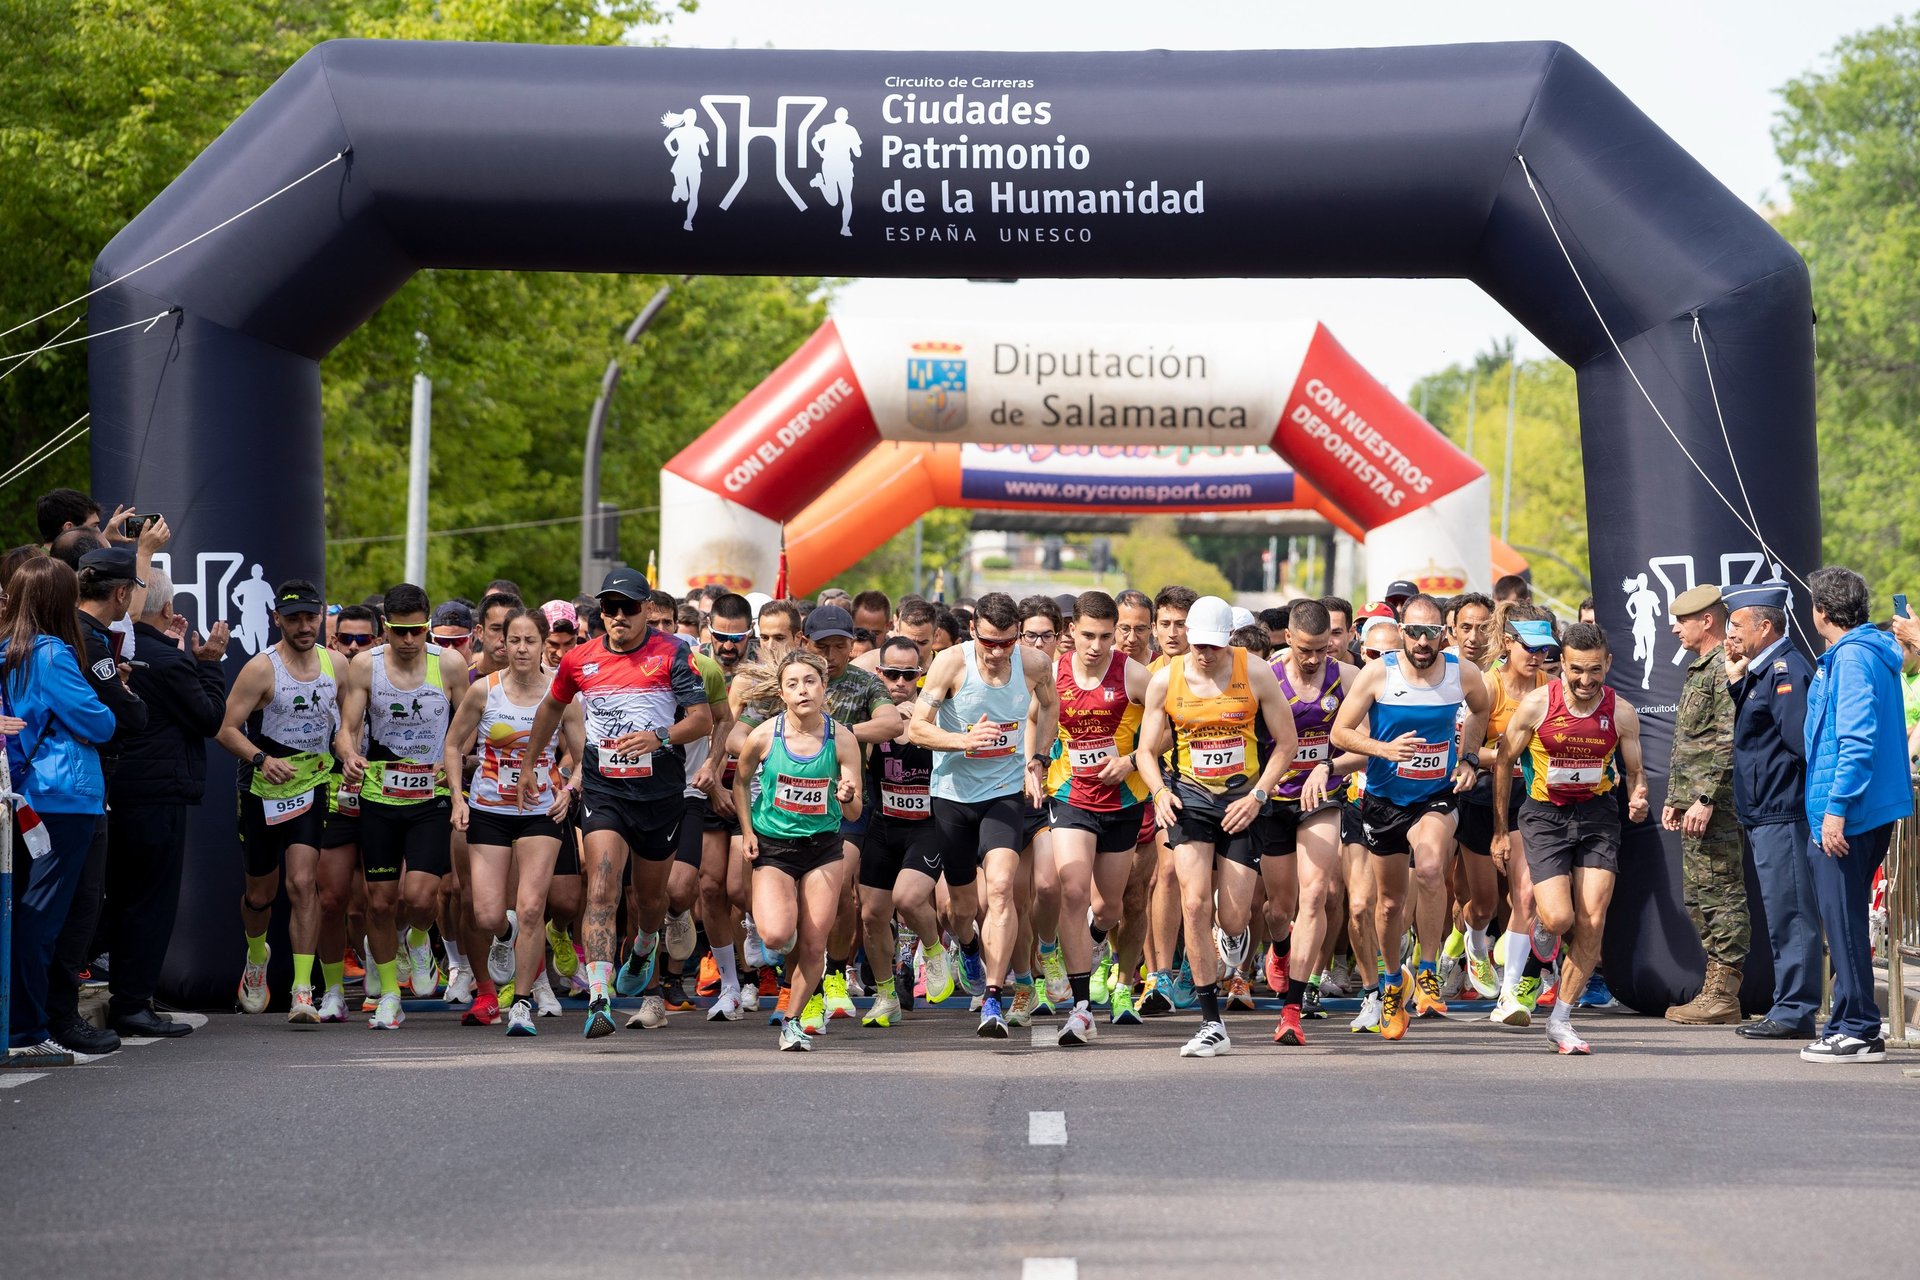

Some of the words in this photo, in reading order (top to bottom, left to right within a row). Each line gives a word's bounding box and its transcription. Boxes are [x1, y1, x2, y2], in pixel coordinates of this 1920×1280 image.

[885, 76, 944, 88] Circuito
[948, 76, 968, 88] de
[971, 76, 1035, 89] Carreras
[882, 93, 1052, 125] Ciudades
[882, 134, 1090, 170] Patrimonio
[881, 179, 925, 213] de
[941, 179, 974, 213] la
[990, 180, 1205, 214] Humanidad
[885, 224, 977, 242] ESPAÑA
[999, 227, 1092, 243] UNESCO
[994, 343, 1206, 386] Diputación
[990, 401, 1024, 426] de
[1041, 394, 1247, 428] Salamanca
[723, 454, 764, 492] CON
[756, 440, 784, 464] EL
[776, 377, 854, 448] DEPORTE
[1305, 378, 1347, 419] CON
[1339, 410, 1433, 494] NUESTROS
[1291, 404, 1406, 508] DEPORTISTAS
[1005, 480, 1251, 502] www.orycronsport.com
[592, 697, 626, 720] Simón
[1077, 718, 1101, 726] VINO
[1203, 751, 1233, 765] 797
[1294, 748, 1318, 760] 16
[1565, 746, 1591, 754] VINO
[1412, 756, 1440, 768] 250
[391, 774, 428, 787] 1128
[1570, 771, 1580, 782] 4
[276, 796, 305, 813] 955
[784, 788, 822, 803] 1748
[889, 795, 924, 809] 1803
